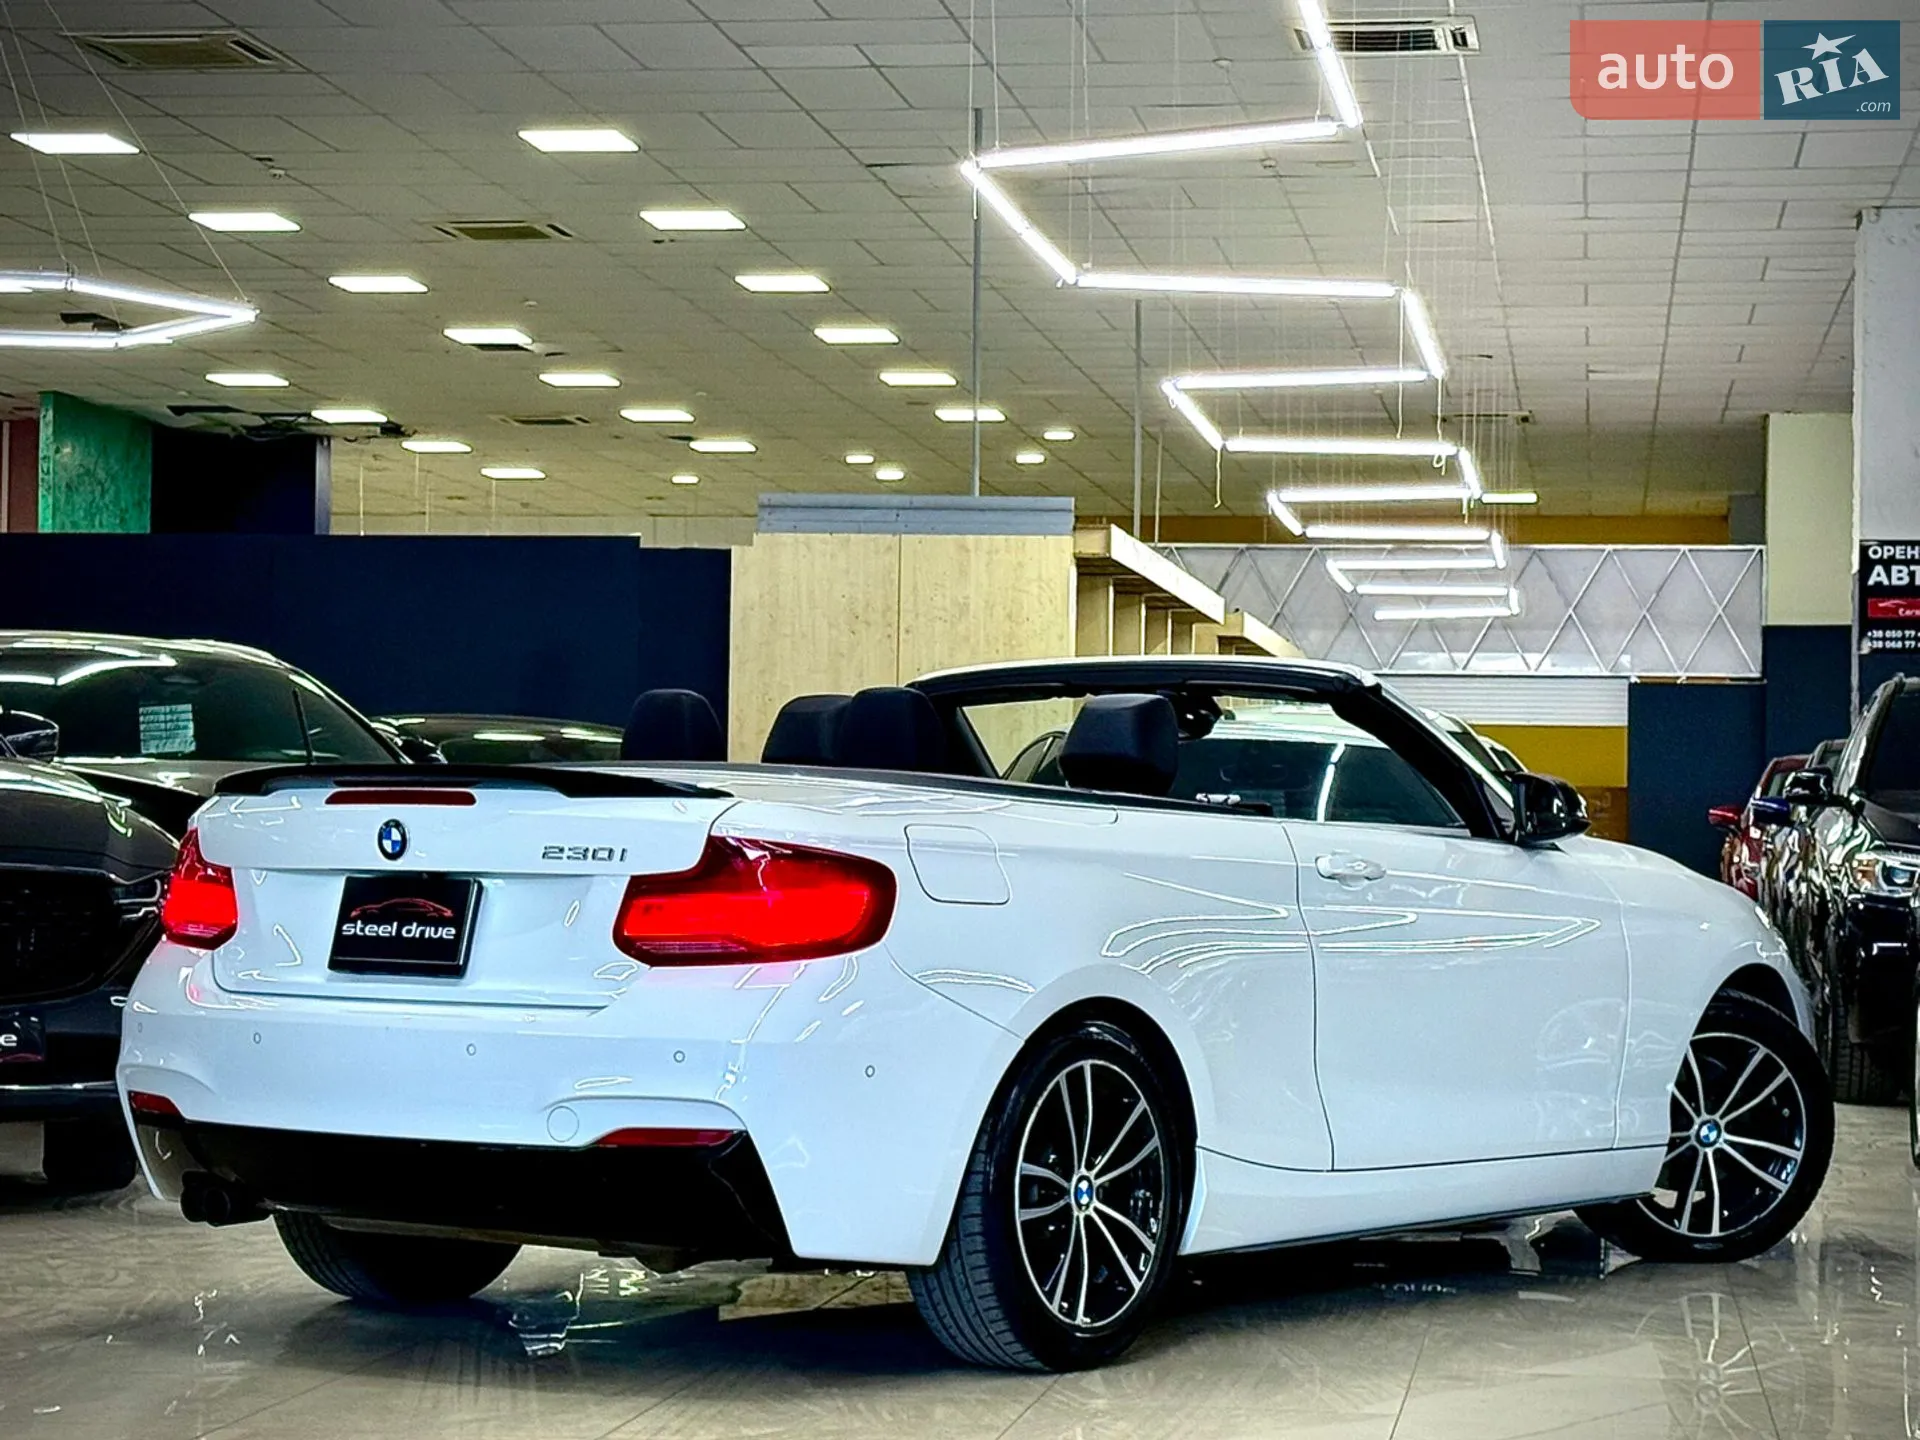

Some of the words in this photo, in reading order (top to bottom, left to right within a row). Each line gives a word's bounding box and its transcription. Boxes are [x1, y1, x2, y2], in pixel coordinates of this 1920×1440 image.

[1904, 630, 1915, 638] 77
[1904, 640, 1915, 648] 77
[341, 920, 398, 936] steel
[401, 922, 456, 939] drive
[0, 1034, 17, 1047] e
